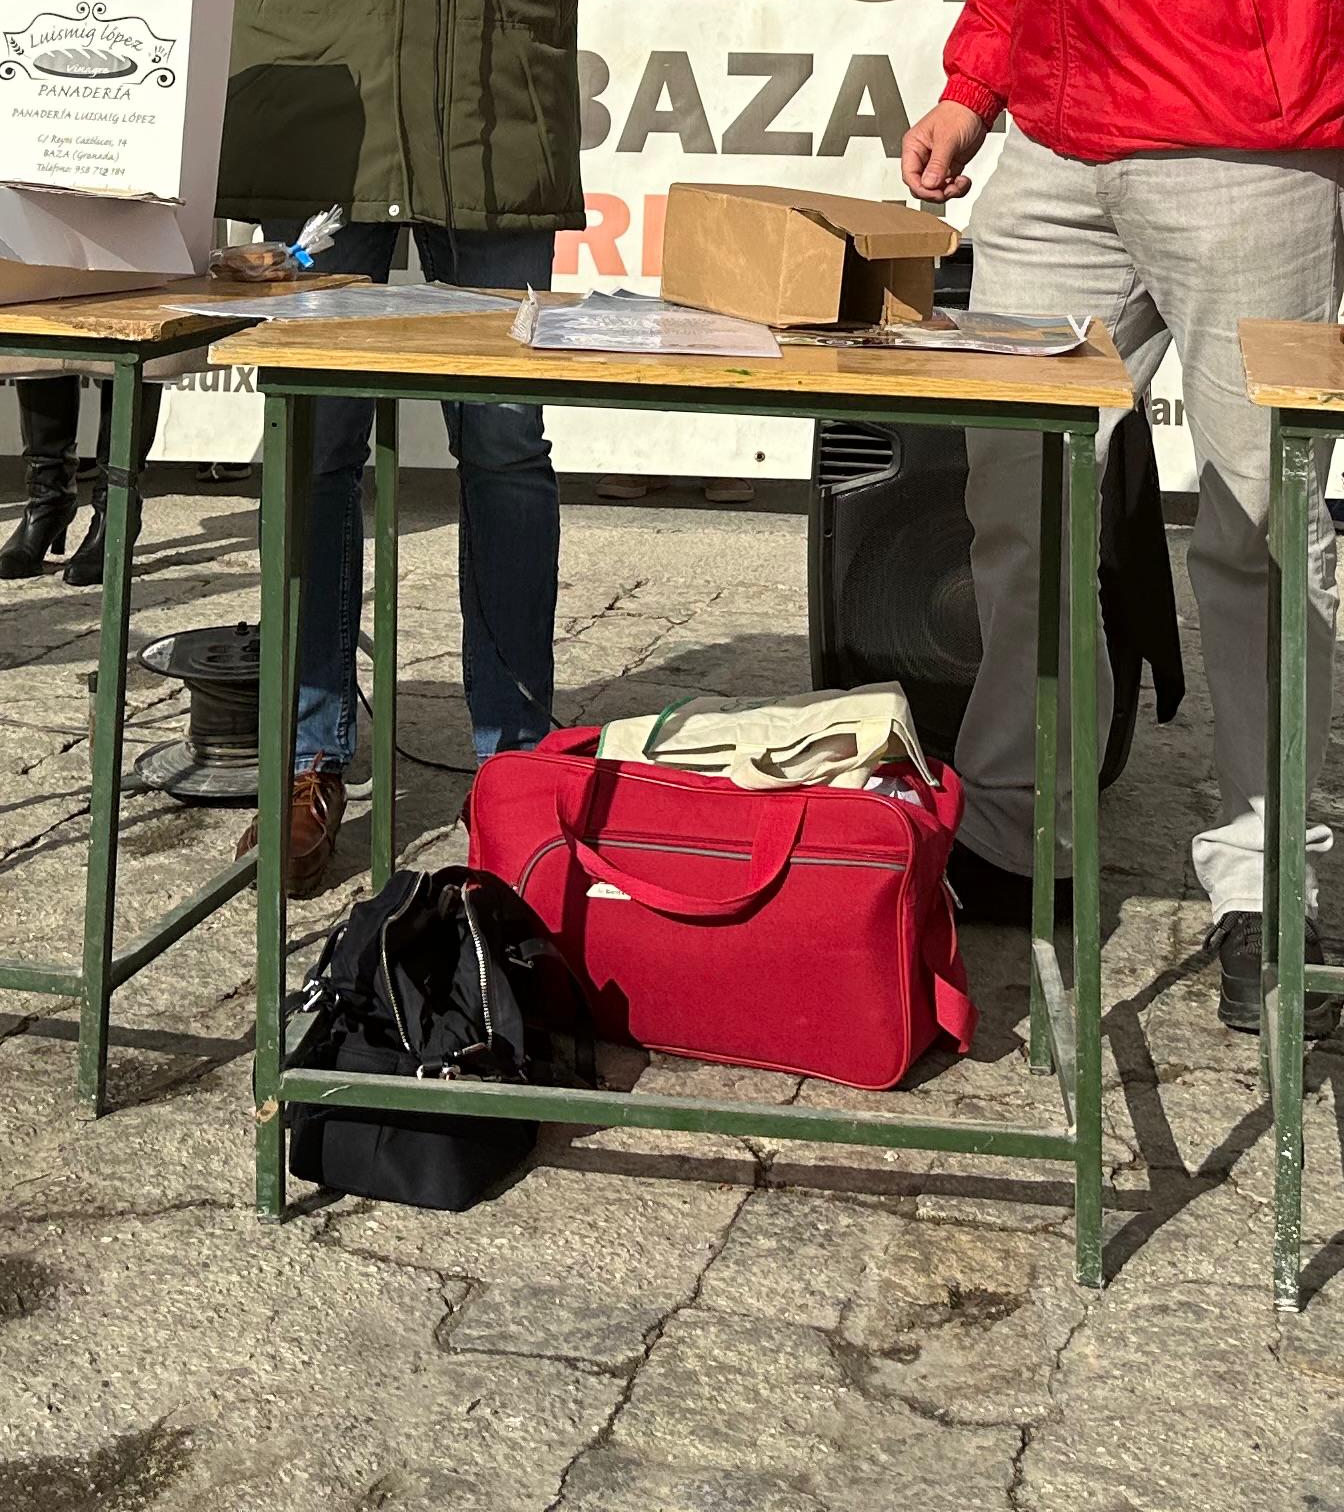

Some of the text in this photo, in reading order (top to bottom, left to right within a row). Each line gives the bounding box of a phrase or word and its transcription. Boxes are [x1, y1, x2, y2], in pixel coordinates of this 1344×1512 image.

[37, 83, 132, 101] PANADERÍA
[11, 107, 72, 120] PANADERÍA
[121, 111, 156, 125] LÓPEZ
[43, 149, 120, 163] BAZA (Granada)
